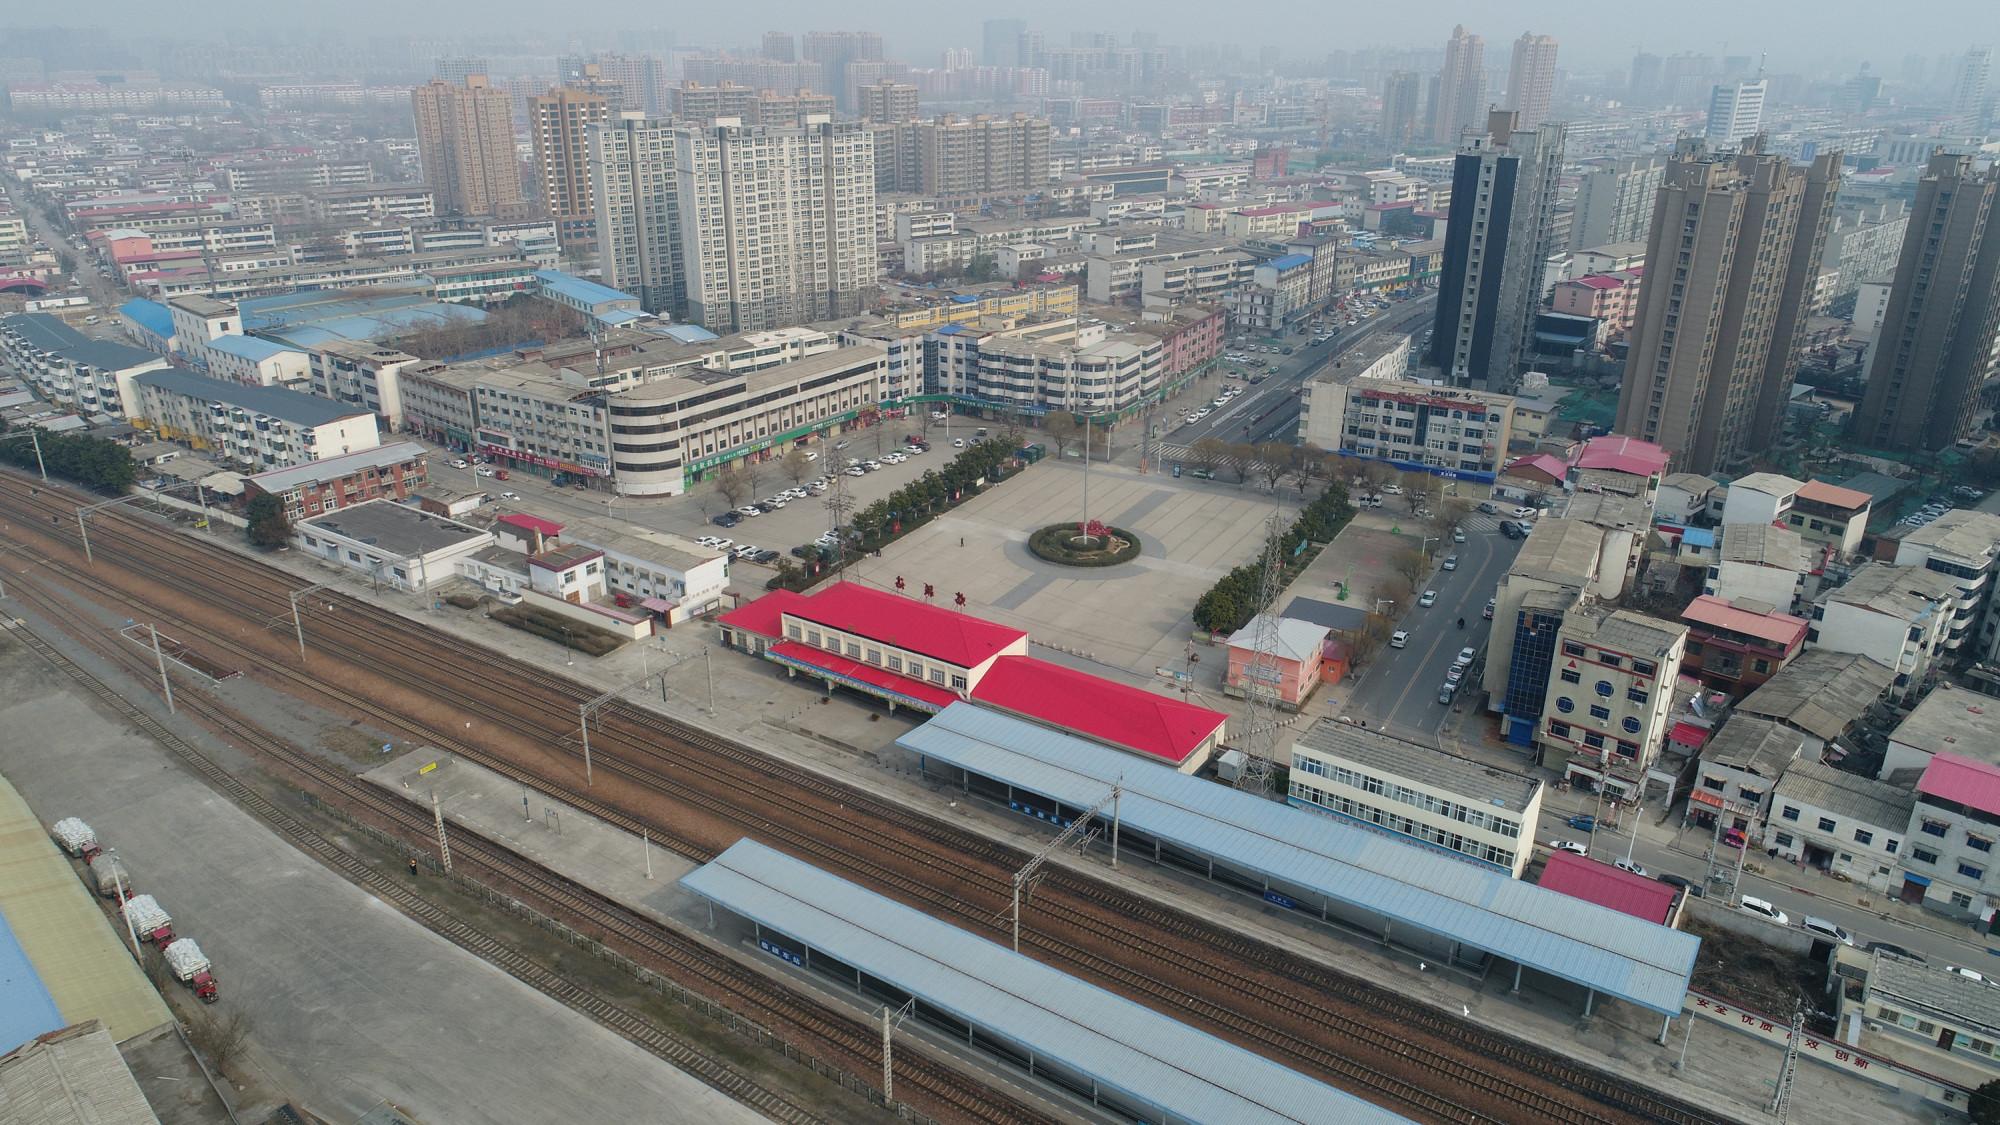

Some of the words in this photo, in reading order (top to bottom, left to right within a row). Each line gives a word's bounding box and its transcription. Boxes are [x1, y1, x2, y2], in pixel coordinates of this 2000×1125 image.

[1697, 998, 1728, 1016] 安全
[1741, 1014, 1773, 1033] 优质
[1835, 1049, 1870, 1070] 创新
